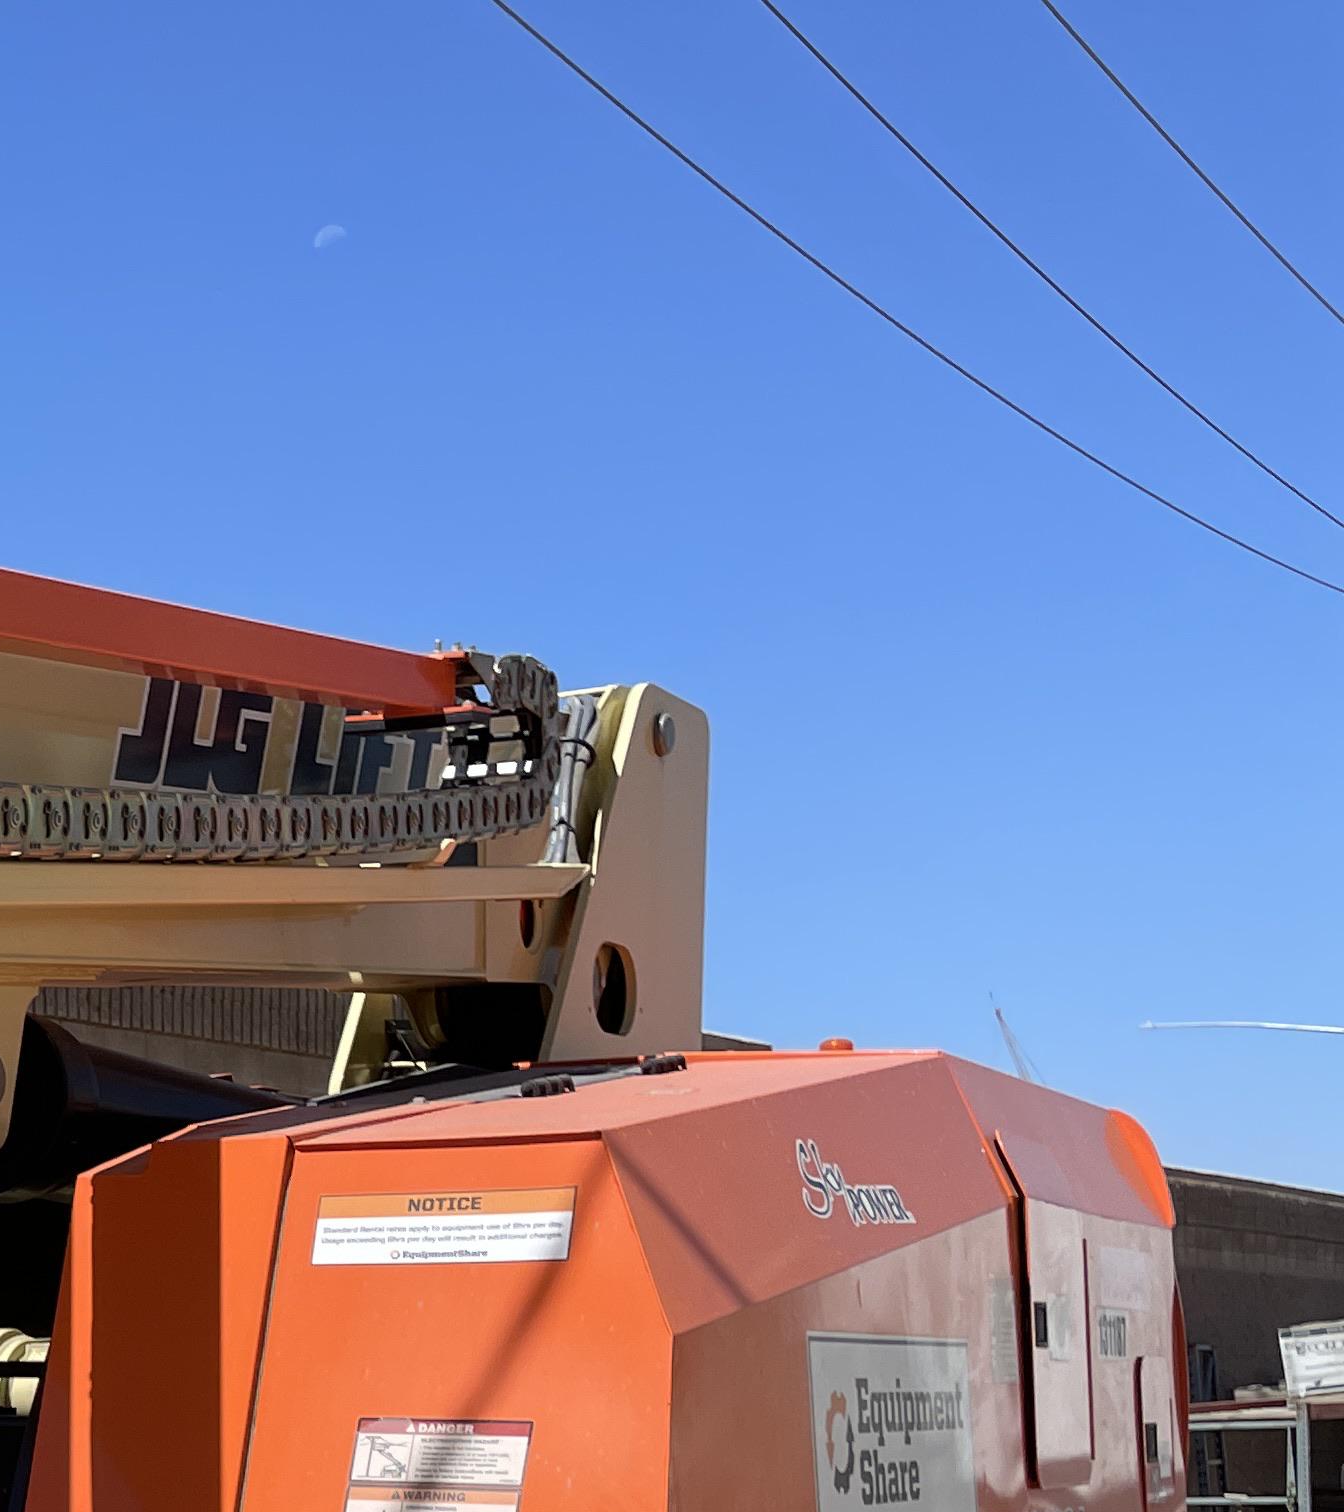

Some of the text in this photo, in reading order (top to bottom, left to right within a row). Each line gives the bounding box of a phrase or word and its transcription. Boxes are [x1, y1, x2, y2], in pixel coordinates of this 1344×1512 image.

[112, 677, 272, 794] JLG
[408, 1197, 482, 1212] NOTICE
[442, 1224, 484, 1232] equipment
[402, 1250, 488, 1259] EquipmentShare
[855, 1378, 964, 1447] Equipment
[418, 1423, 474, 1434] DANGER
[860, 1449, 921, 1505] Share
[403, 1491, 466, 1502] WARNING
